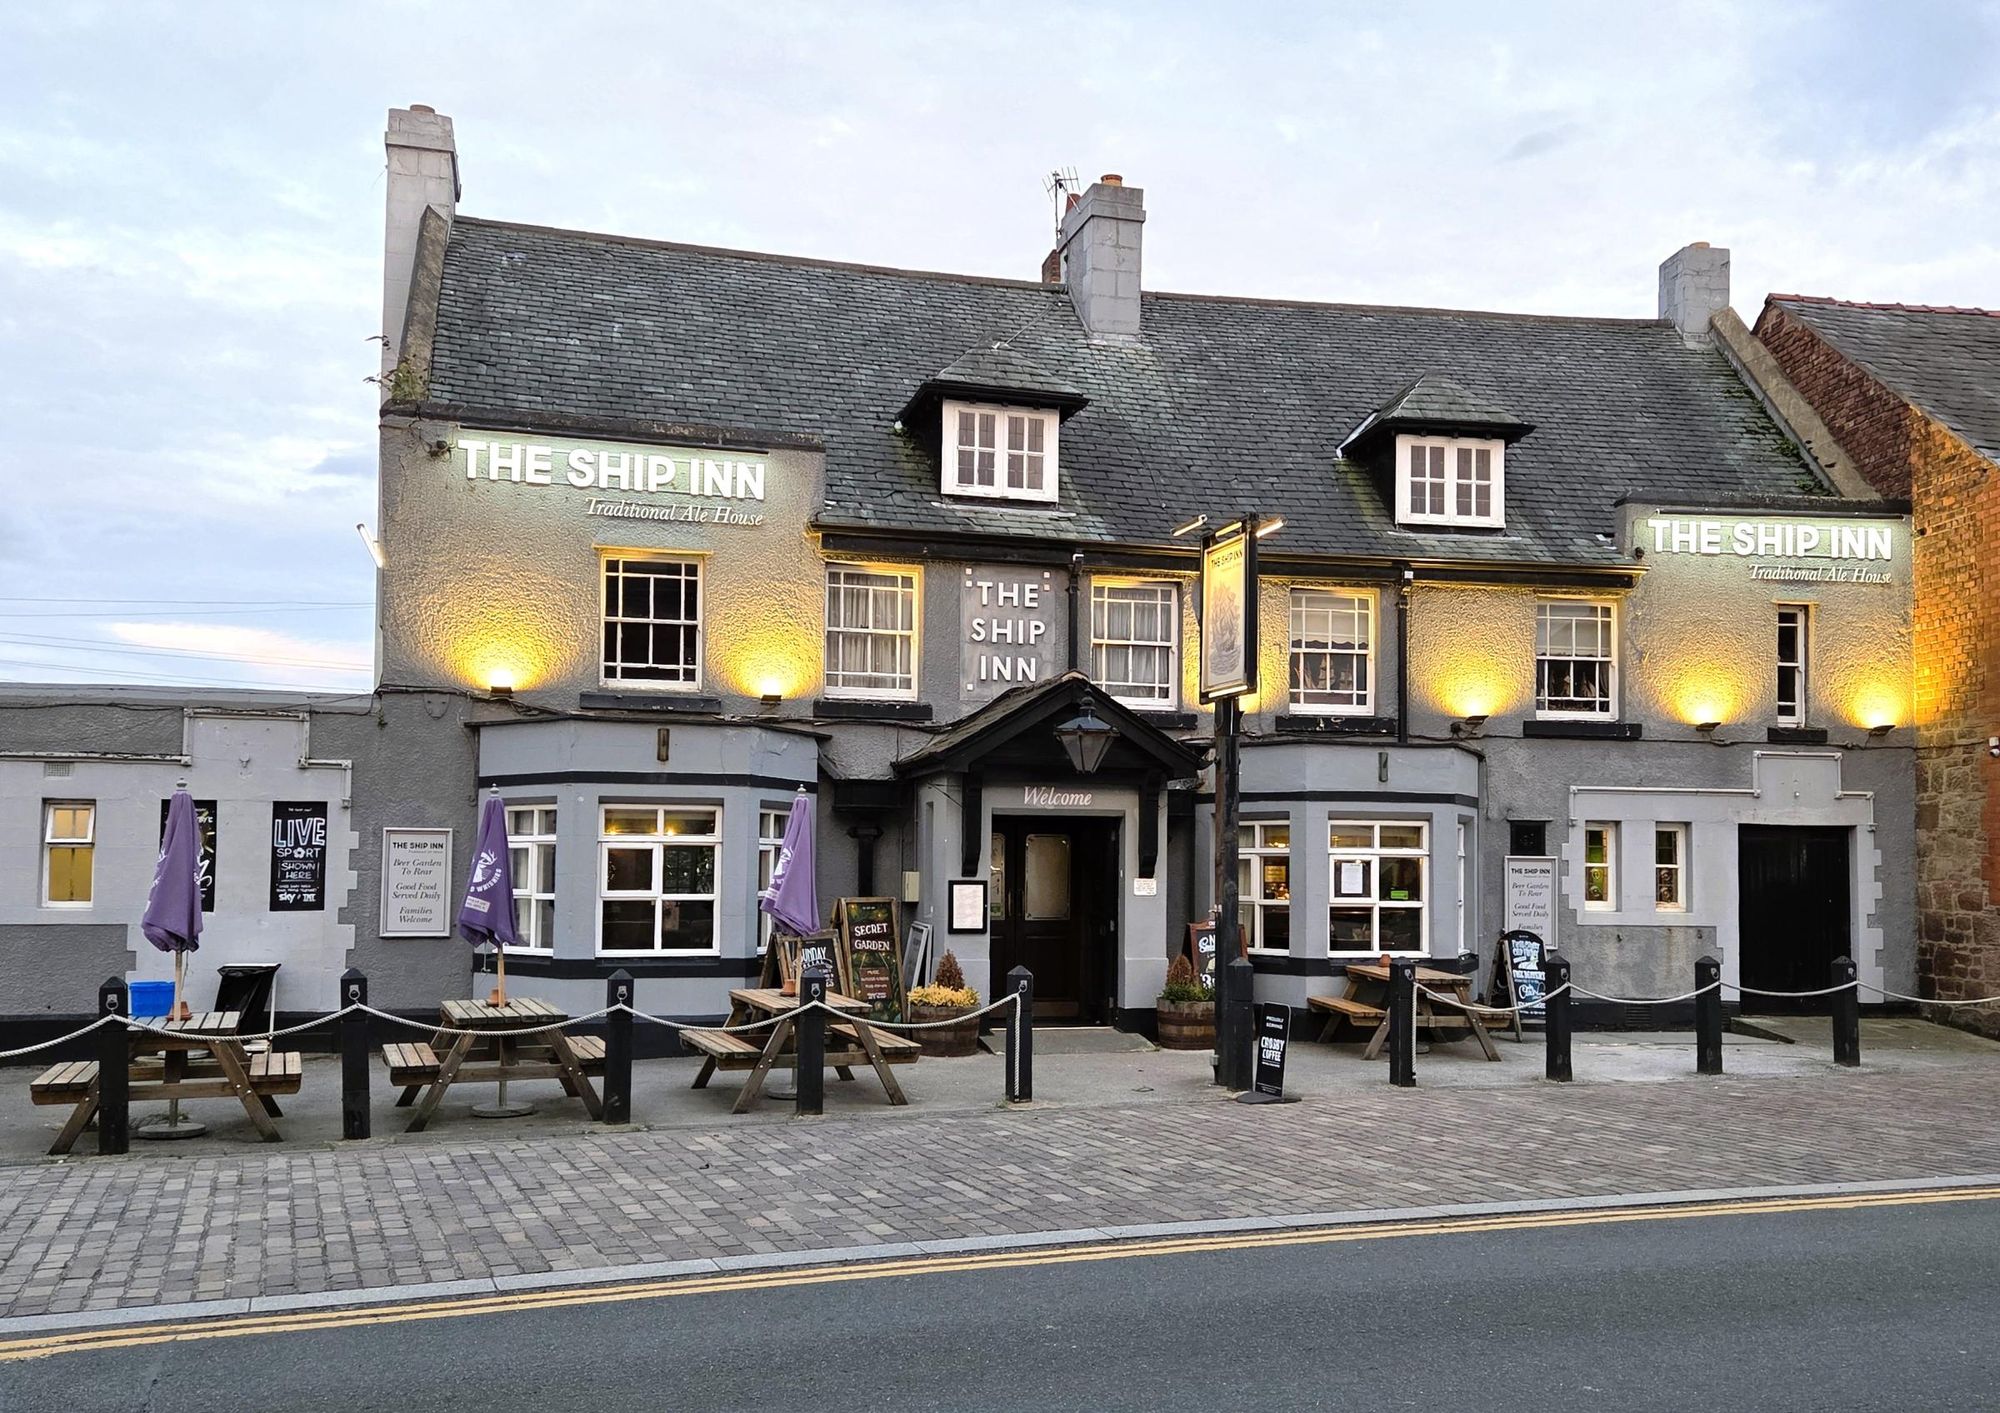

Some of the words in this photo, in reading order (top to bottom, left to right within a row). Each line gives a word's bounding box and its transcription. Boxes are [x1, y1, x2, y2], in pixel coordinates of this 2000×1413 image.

[458, 439, 551, 484] THE
[566, 449, 676, 492] SHIP
[690, 458, 765, 500] INN
[585, 497, 676, 521] Traditional
[682, 507, 707, 523] Ale
[711, 507, 763, 526] House
[1648, 519, 1721, 554] THE
[1732, 522, 1820, 557] SHIP
[1830, 525, 1892, 560] INN
[1749, 563, 1823, 581] Traditional
[1825, 567, 1848, 582] Ale
[1850, 568, 1893, 584] House
[976, 581, 1039, 608] THE
[970, 618, 1046, 645] SHIP
[980, 655, 1036, 682] INN
[1023, 786, 1092, 806] Welcome
[274, 817, 326, 847] LIVE
[392, 842, 407, 850] THE
[409, 842, 428, 850] SHIP
[430, 842, 444, 850] INN
[281, 862, 316, 871] SHOWN
[393, 858, 410, 867] Beer
[412, 858, 442, 867] Garden
[285, 871, 312, 879] HERE
[401, 867, 412, 876] To
[413, 867, 433, 876] Rear
[395, 882, 417, 891] Good
[418, 882, 437, 891] Food
[278, 892, 296, 904] sky
[392, 891, 418, 900] Served
[420, 891, 441, 902] Daily
[399, 906, 433, 915] Families
[1514, 902, 1530, 910] Good
[399, 915, 433, 923] Welcome
[854, 923, 888, 937] SECRET
[854, 939, 890, 951] GARDEN
[1262, 1048, 1282, 1062] COFFEE
